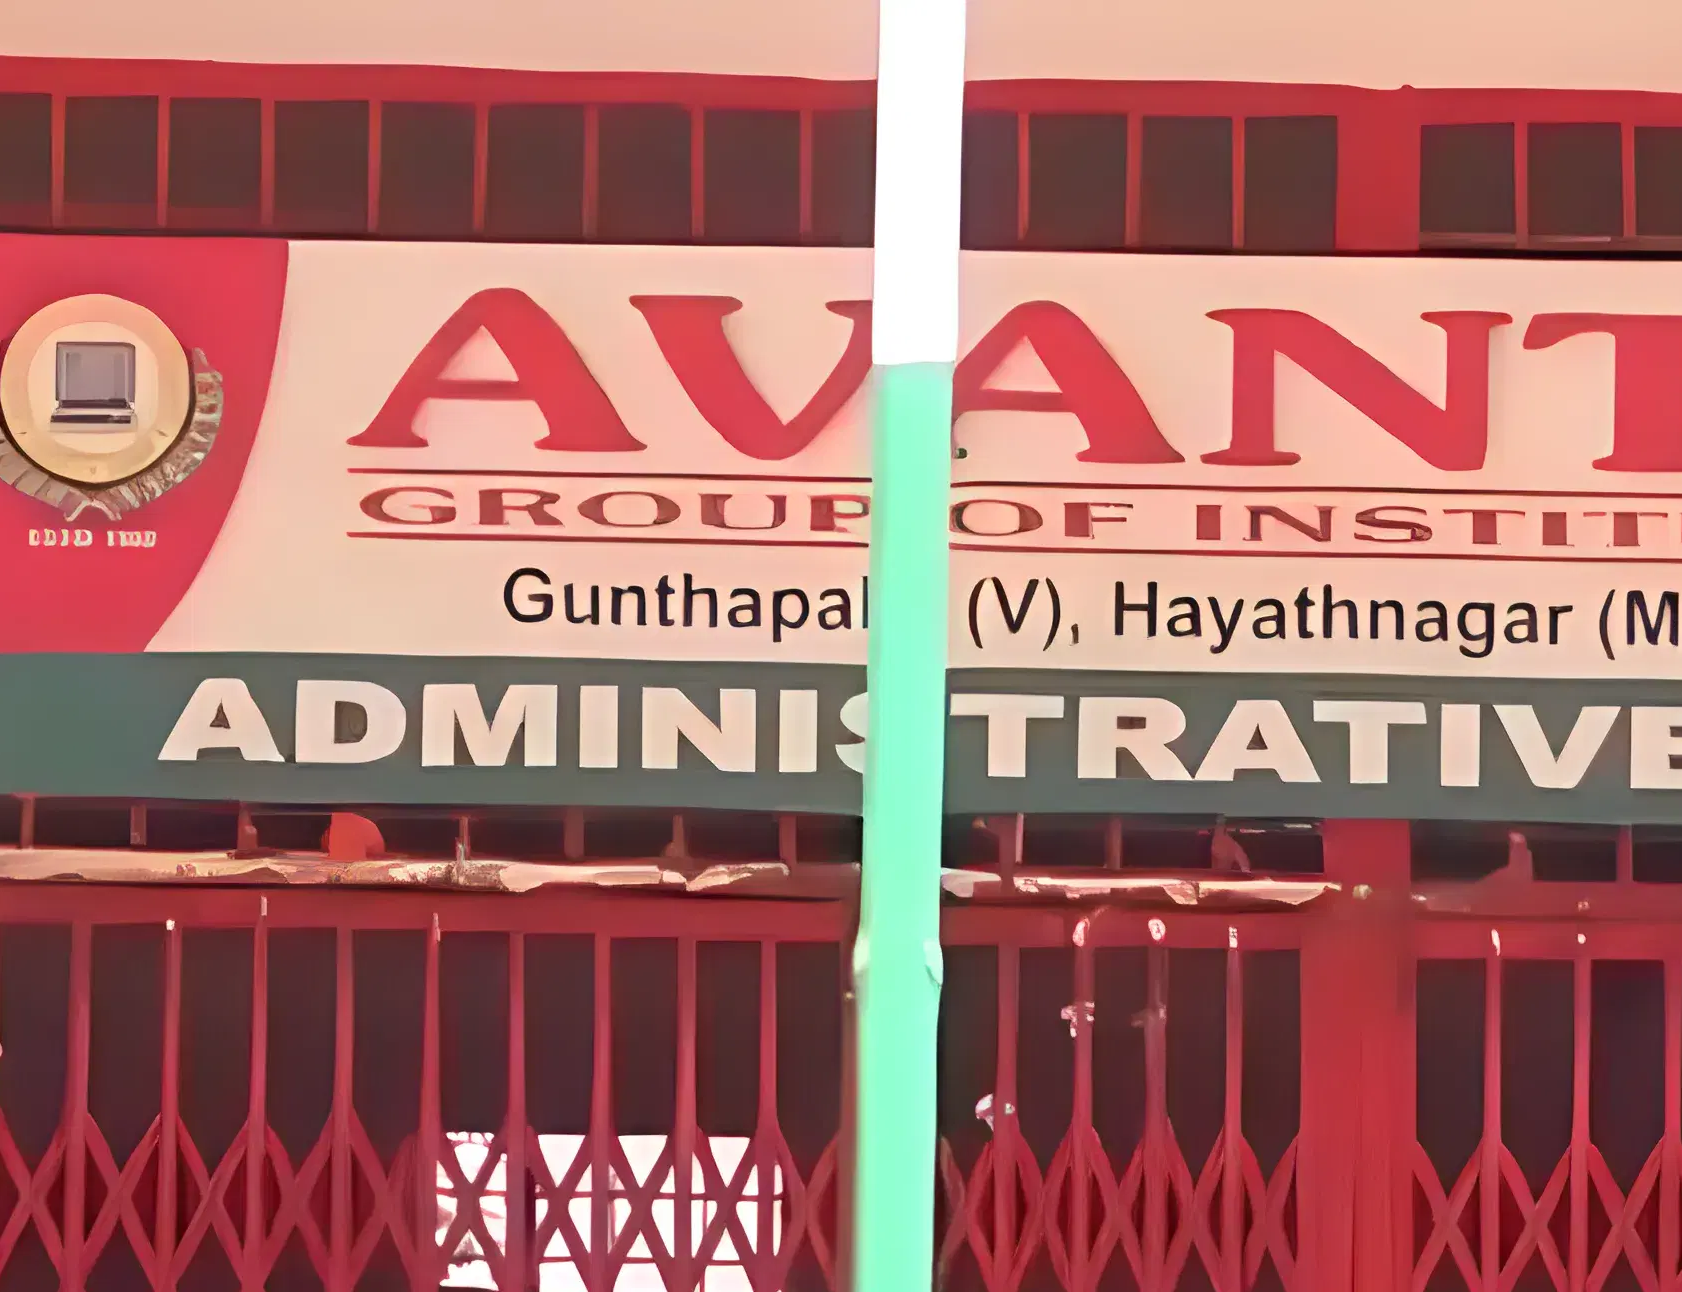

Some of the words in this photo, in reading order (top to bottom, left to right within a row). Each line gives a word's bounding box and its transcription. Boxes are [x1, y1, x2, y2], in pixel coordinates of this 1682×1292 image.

[359, 489, 871, 531] GROUP
[951, 497, 1133, 540] OF
[502, 566, 869, 642] Gunthapal
[968, 575, 1081, 652] (V),
[1112, 579, 1575, 659] Hayathnagar
